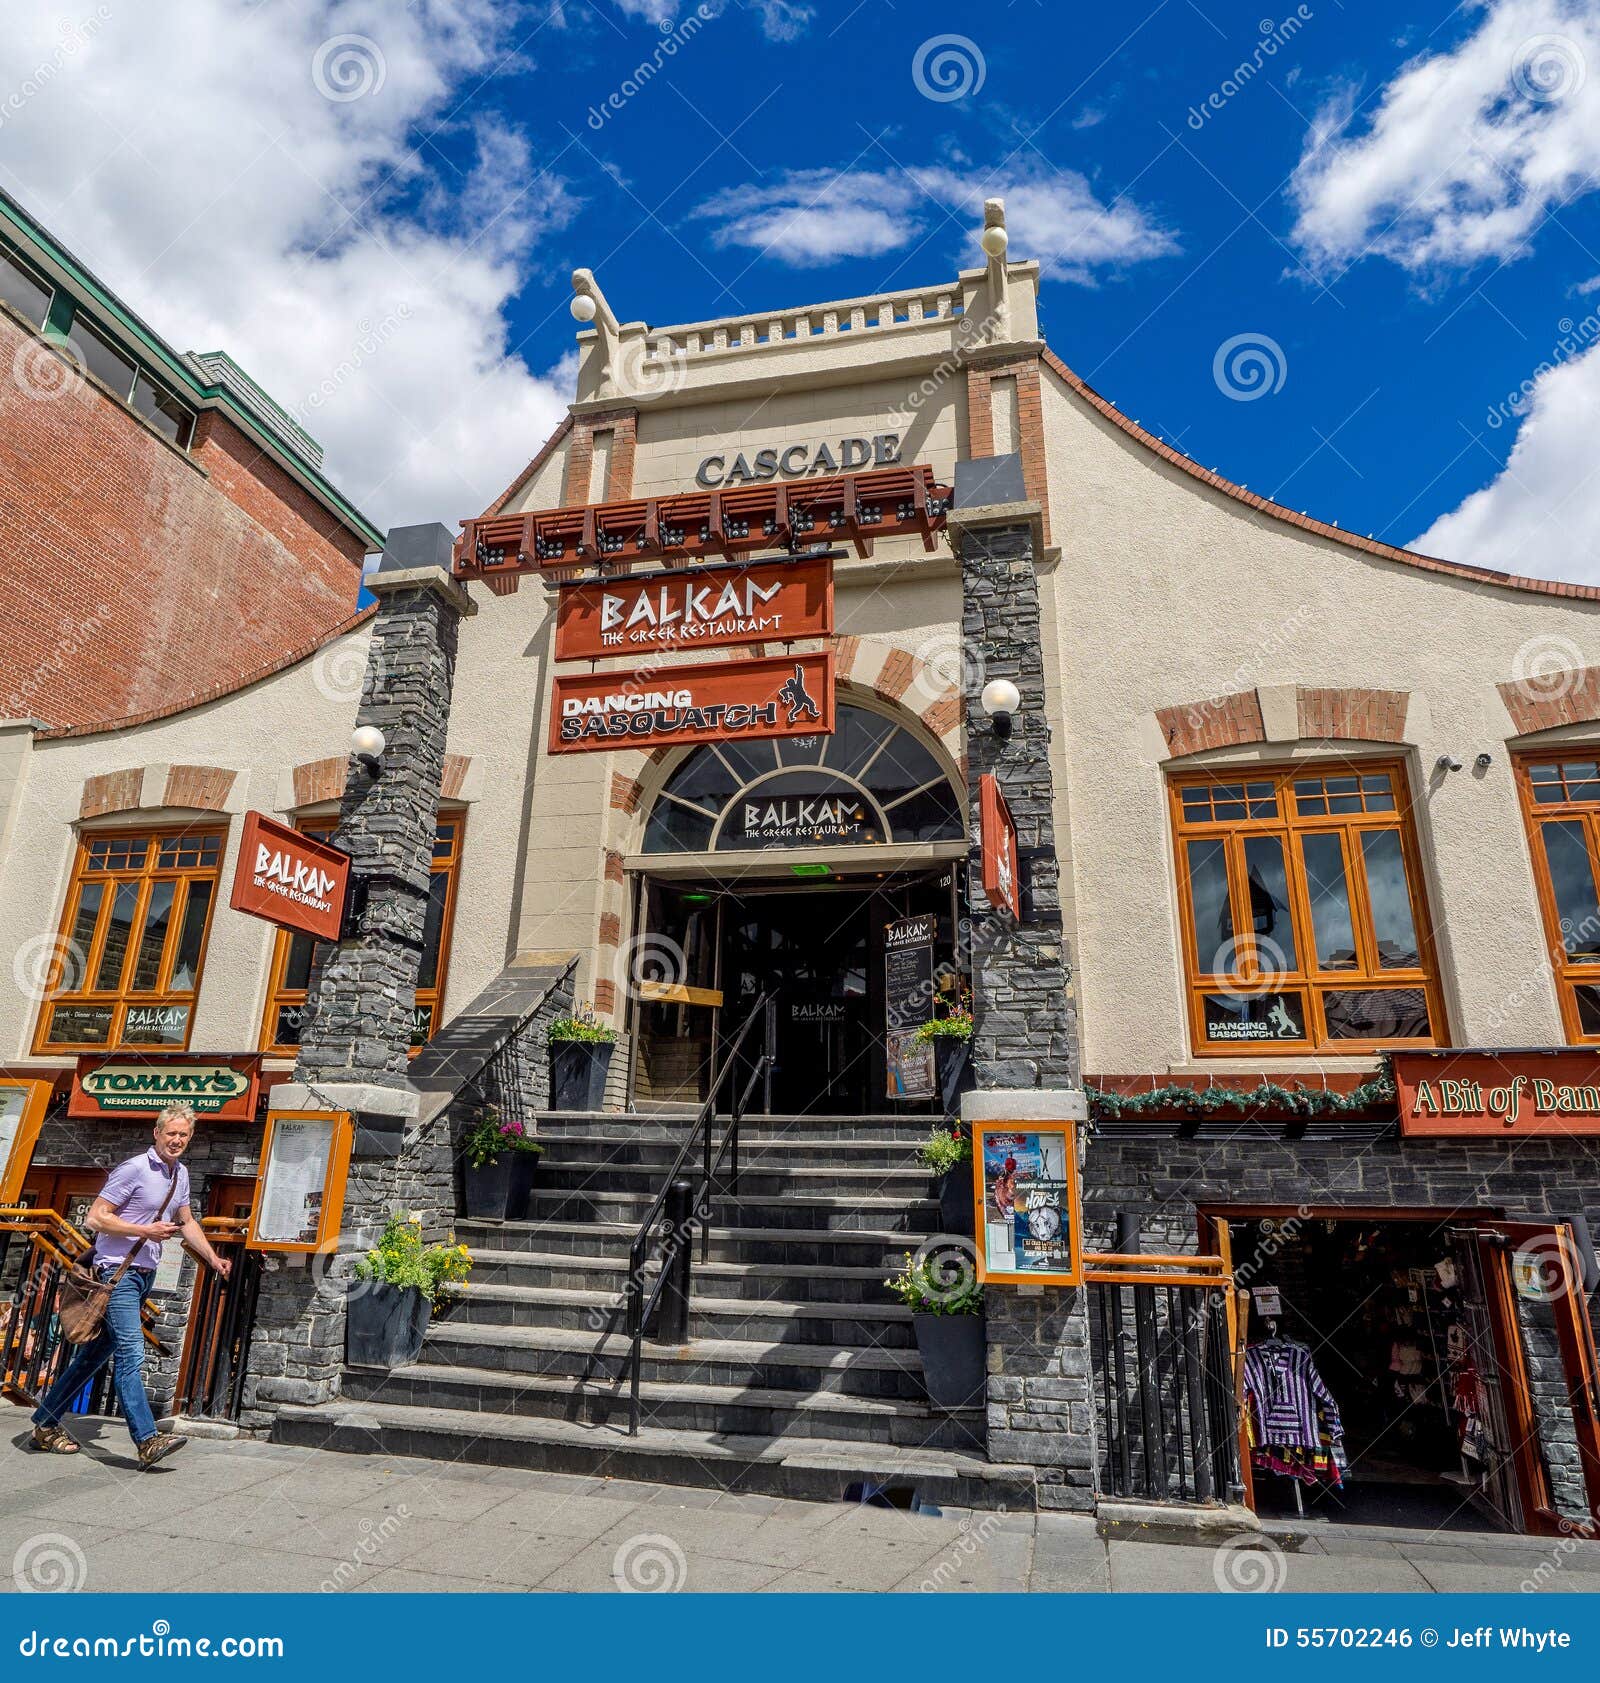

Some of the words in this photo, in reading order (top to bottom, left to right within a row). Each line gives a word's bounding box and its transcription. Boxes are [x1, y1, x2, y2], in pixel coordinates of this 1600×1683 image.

[696, 433, 901, 485] CASCADE
[601, 577, 782, 631] BALKAN
[601, 632, 625, 646] THE
[630, 627, 676, 643] GREEK
[680, 614, 783, 639] RESTAURANT
[562, 689, 693, 717] DANCING
[561, 702, 778, 740] SASQUATCH
[745, 798, 860, 829] BALKAN
[745, 829, 760, 839] THE
[763, 827, 793, 838] GREEK
[795, 823, 860, 837] RESTAURANT
[254, 842, 336, 899] BALKAN
[940, 875, 951, 888] 120
[253, 874, 267, 888] THE
[267, 880, 288, 897] GREEK
[289, 888, 332, 913] RESTAURANT
[888, 922, 928, 942] BALKAN
[127, 1008, 188, 1025] BALKAN
[792, 1003, 845, 1017] BALKAN
[1208, 1022, 1268, 1031] DANCING
[1209, 1030, 1274, 1039] SASQUATCH
[89, 1070, 238, 1092] TOMMY'S
[103, 1097, 195, 1108] NEIGHBOURHOOD
[197, 1099, 221, 1108] PUB
[1414, 1080, 1440, 1113] A
[1439, 1078, 1486, 1113] Bit
[1489, 1075, 1527, 1123] of
